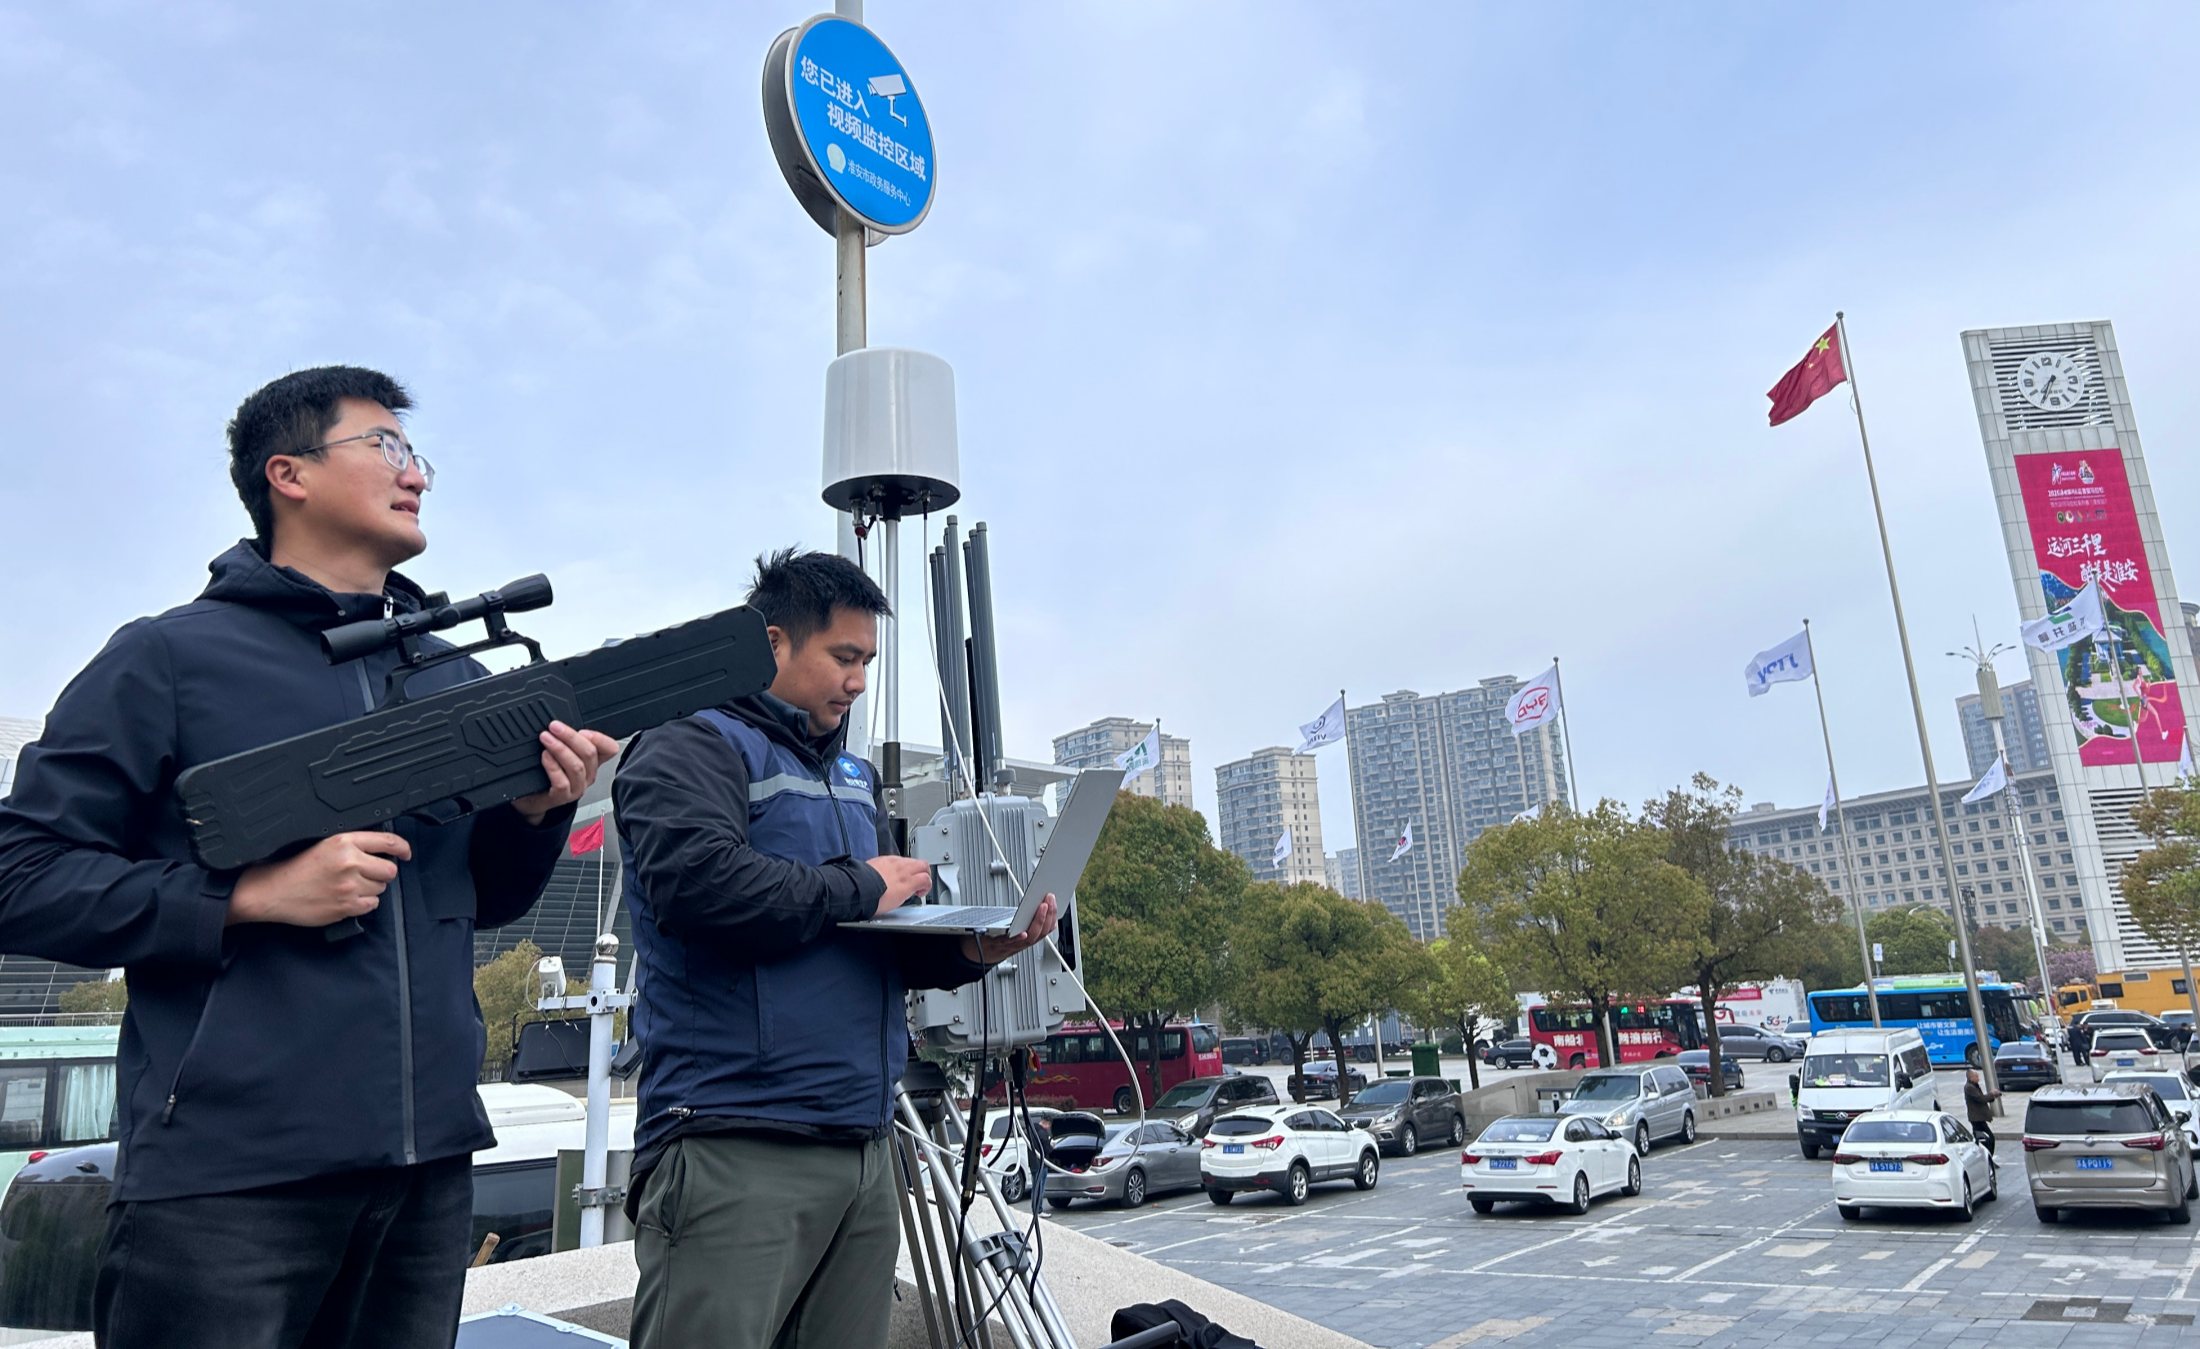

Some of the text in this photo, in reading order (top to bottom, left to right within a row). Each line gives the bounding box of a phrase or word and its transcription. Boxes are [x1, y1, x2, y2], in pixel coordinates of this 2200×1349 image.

[800, 55, 870, 118] 您已进入
[826, 103, 926, 182] 视频监控区域
[847, 159, 911, 207] 淮安市政务服务中心
[2047, 533, 2107, 558] 运河三千里
